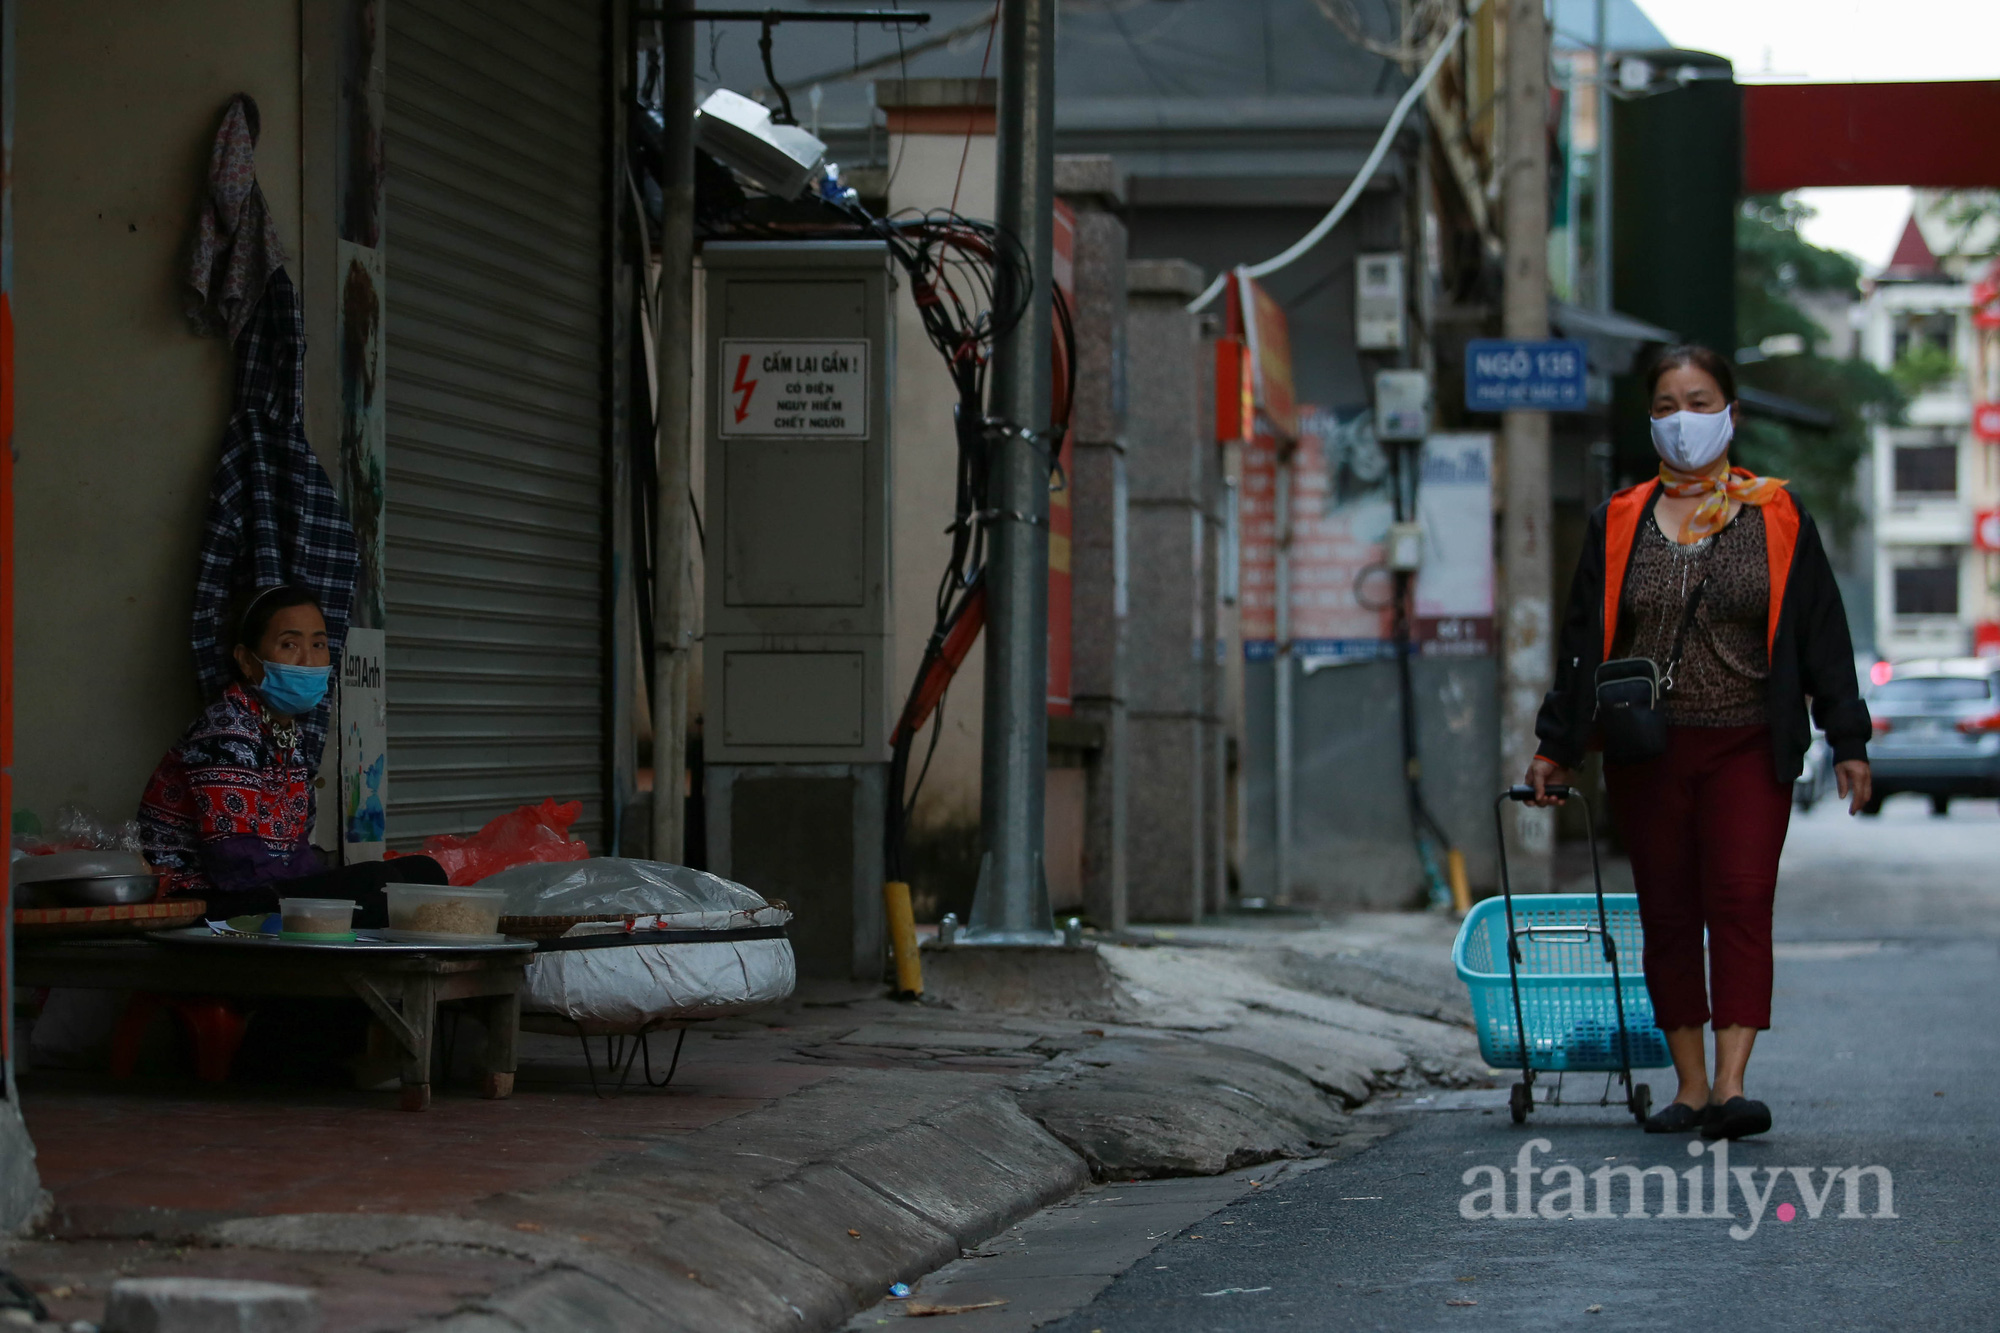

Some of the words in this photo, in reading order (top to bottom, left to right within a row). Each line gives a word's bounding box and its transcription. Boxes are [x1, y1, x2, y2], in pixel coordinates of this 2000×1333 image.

[764, 350, 792, 373] CẤM
[796, 356, 817, 376] LẠI
[822, 350, 848, 373] GẦN
[1477, 345, 1531, 378] NGÕ
[785, 381, 802, 394] CÓ
[806, 381, 834, 396] ĐIỆN
[777, 400, 807, 411] NGUY
[811, 396, 842, 411] HIỂM
[774, 414, 805, 428] CHẾT
[809, 415, 845, 428] NGƯỜI
[345, 645, 361, 688] Lan
[361, 656, 381, 688] Anh
